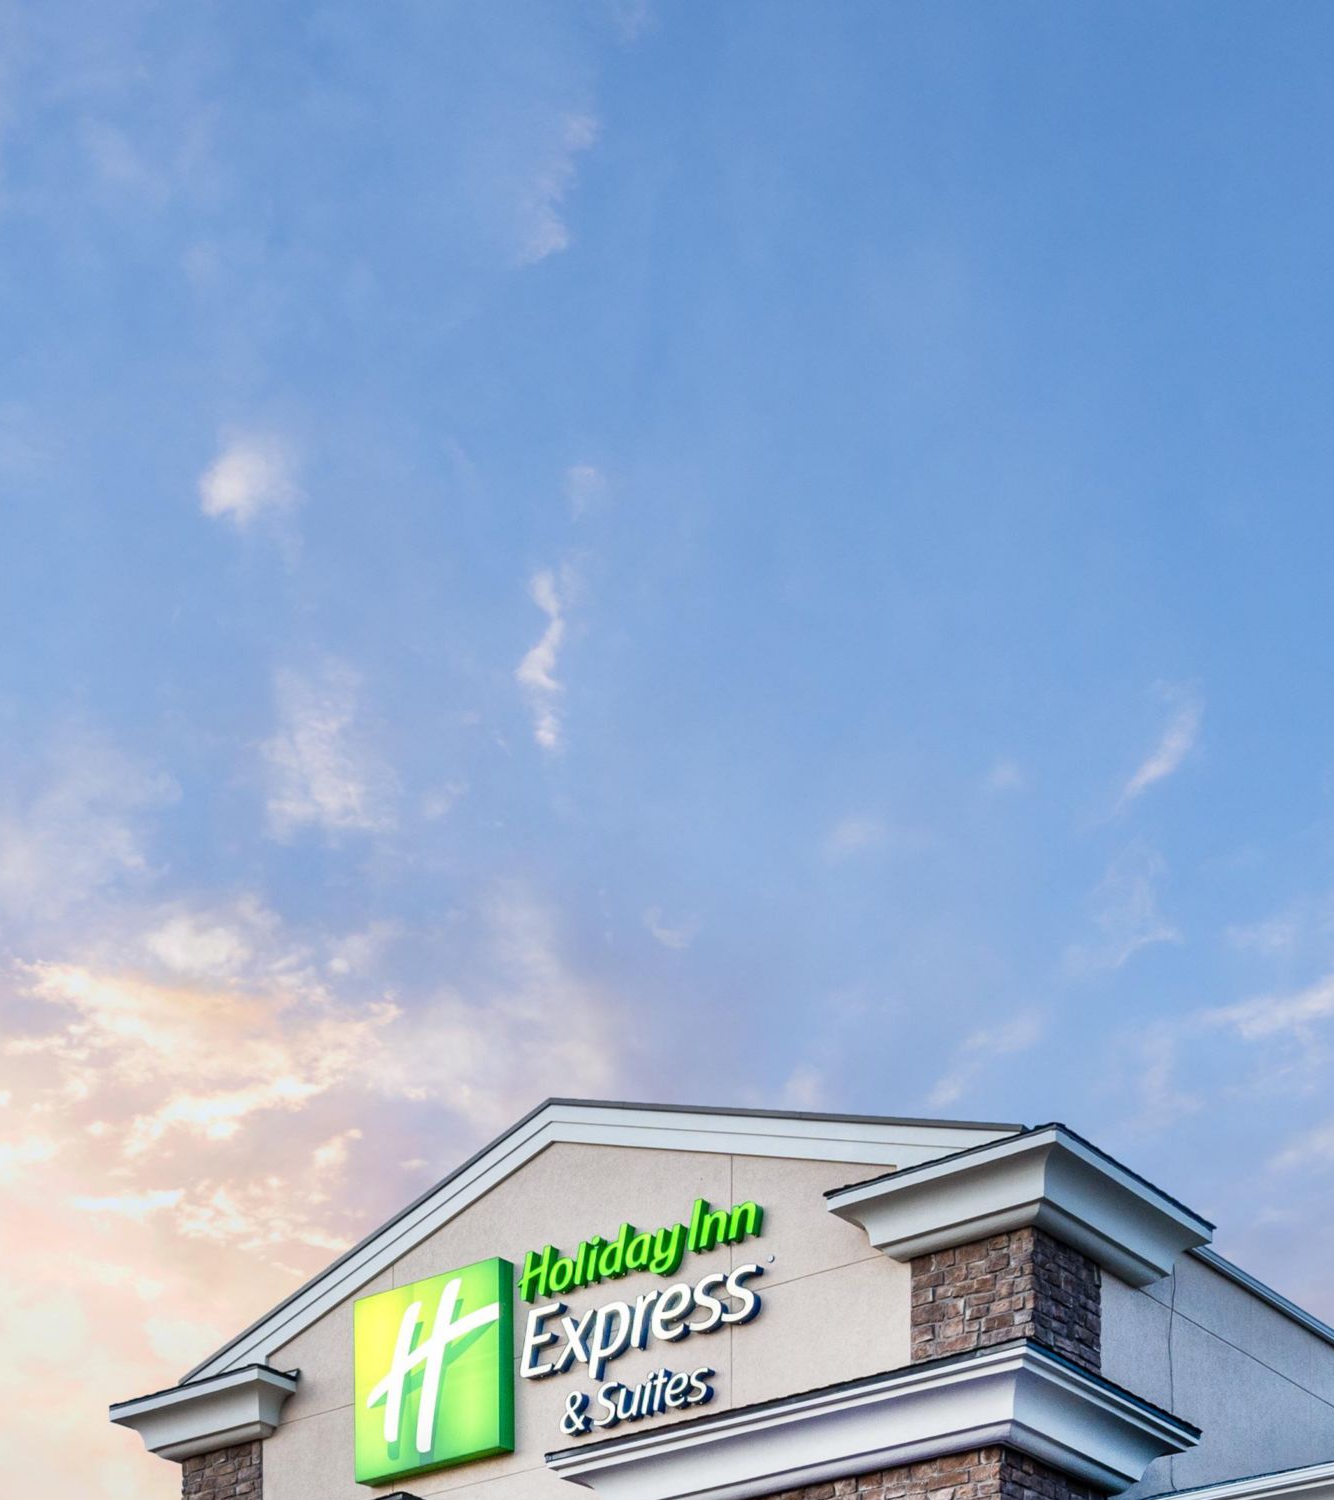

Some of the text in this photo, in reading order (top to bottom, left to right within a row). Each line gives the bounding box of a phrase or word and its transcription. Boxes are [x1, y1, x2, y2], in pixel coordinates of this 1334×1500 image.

[518, 1198, 763, 1303] Holiday Inn
[368, 1278, 499, 1453] H
[520, 1264, 763, 1381] Express
[560, 1368, 715, 1436] & Suites
